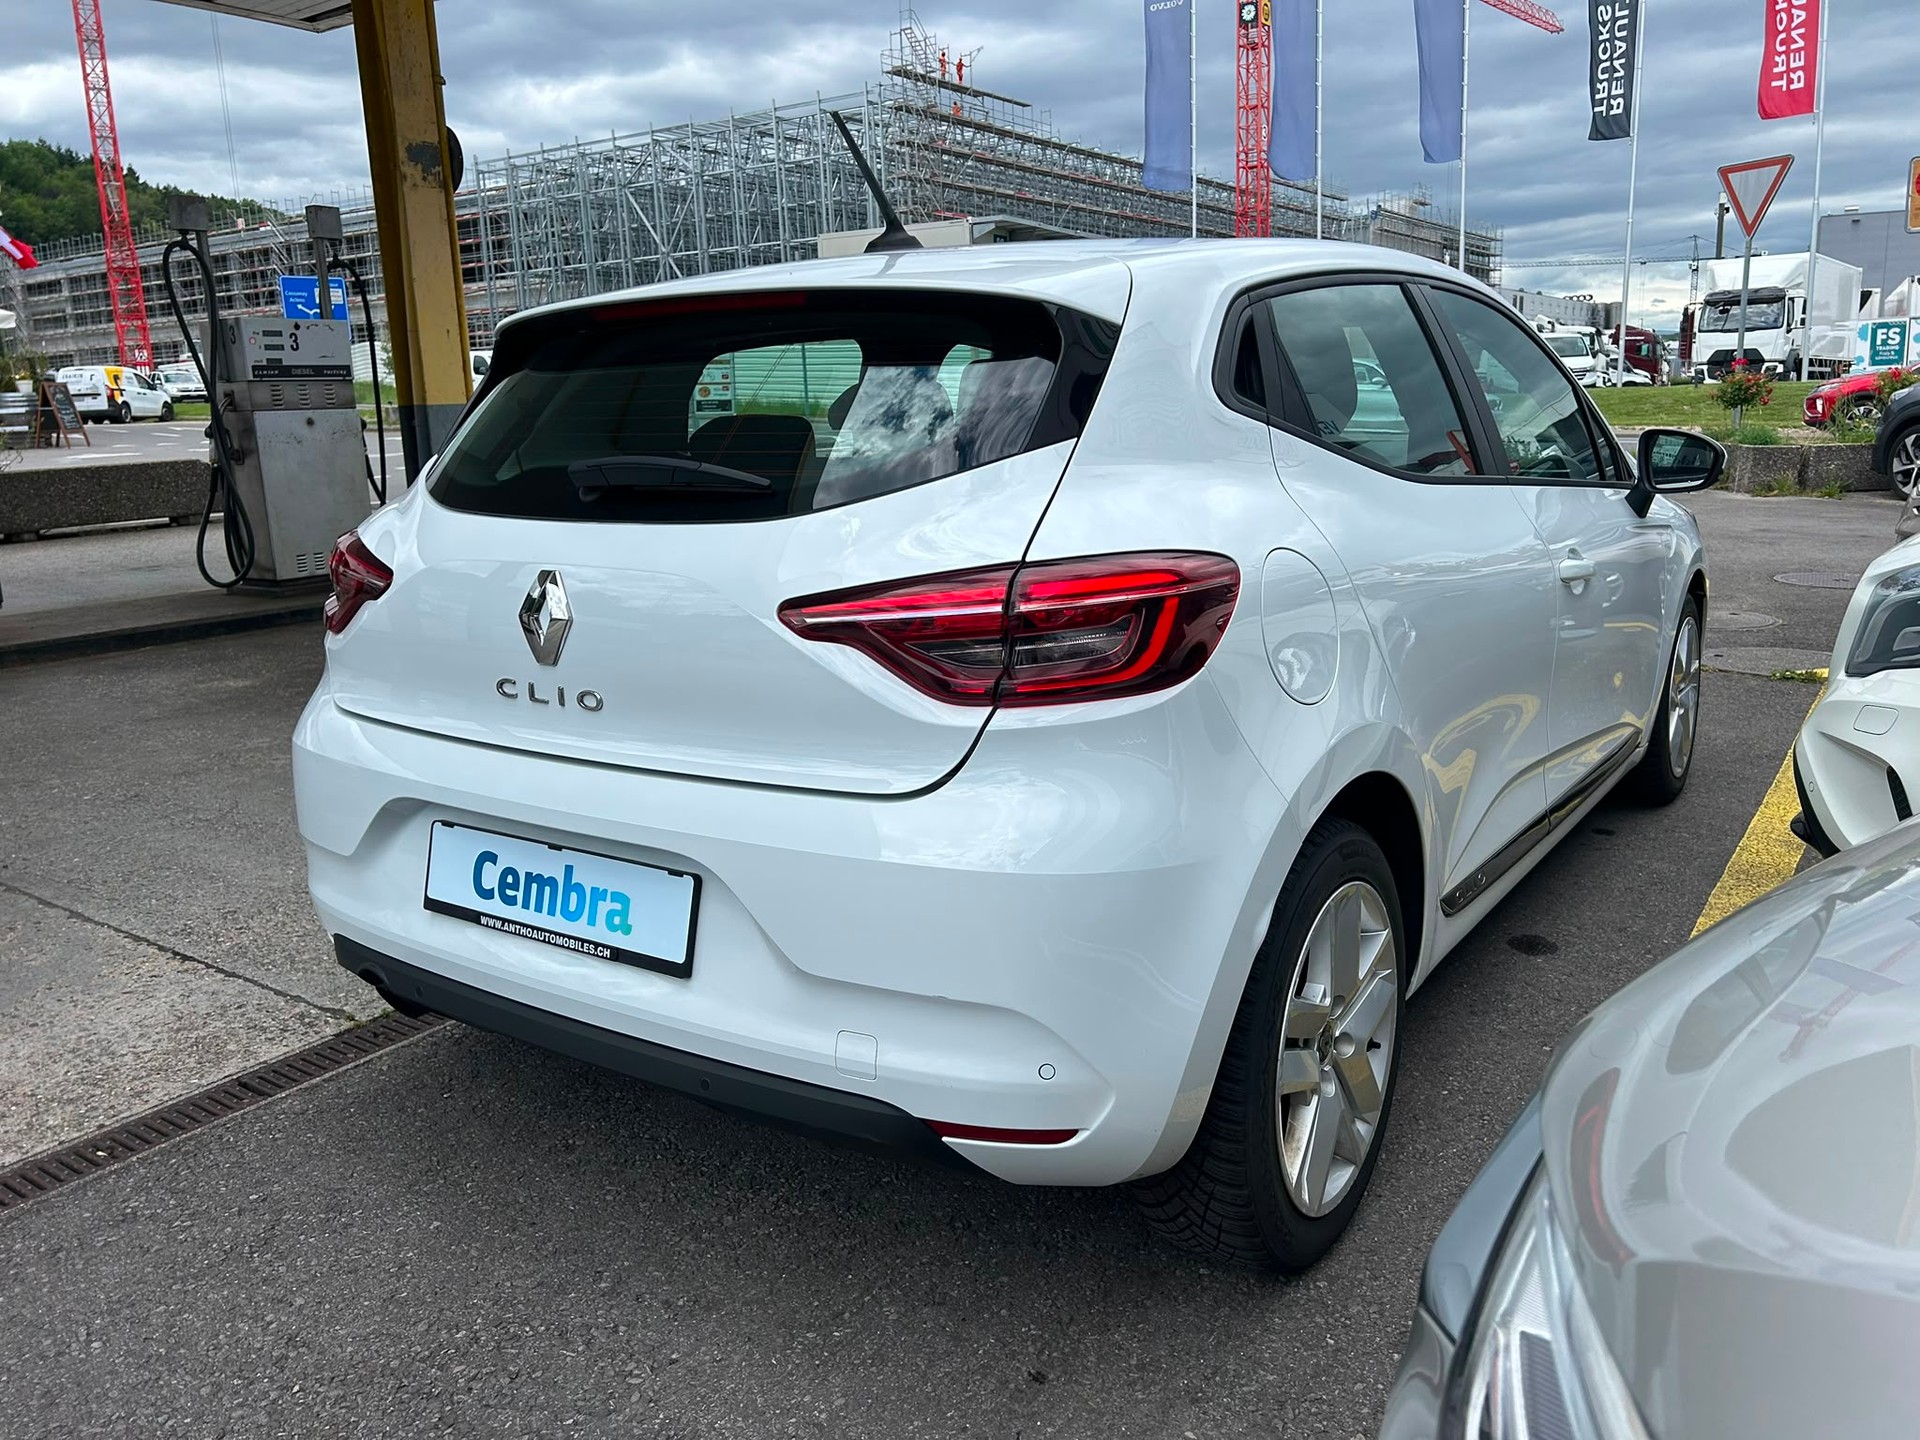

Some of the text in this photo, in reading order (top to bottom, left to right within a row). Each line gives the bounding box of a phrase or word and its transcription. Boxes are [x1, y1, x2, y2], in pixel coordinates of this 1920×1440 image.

[228, 325, 236, 345] 3
[289, 332, 299, 351] 3
[1876, 327, 1901, 345] FS
[496, 677, 604, 712] CLIO
[472, 850, 633, 936] Cembra
[480, 914, 611, 958] WWW.ANTHOAUTOMOBILES.CH
